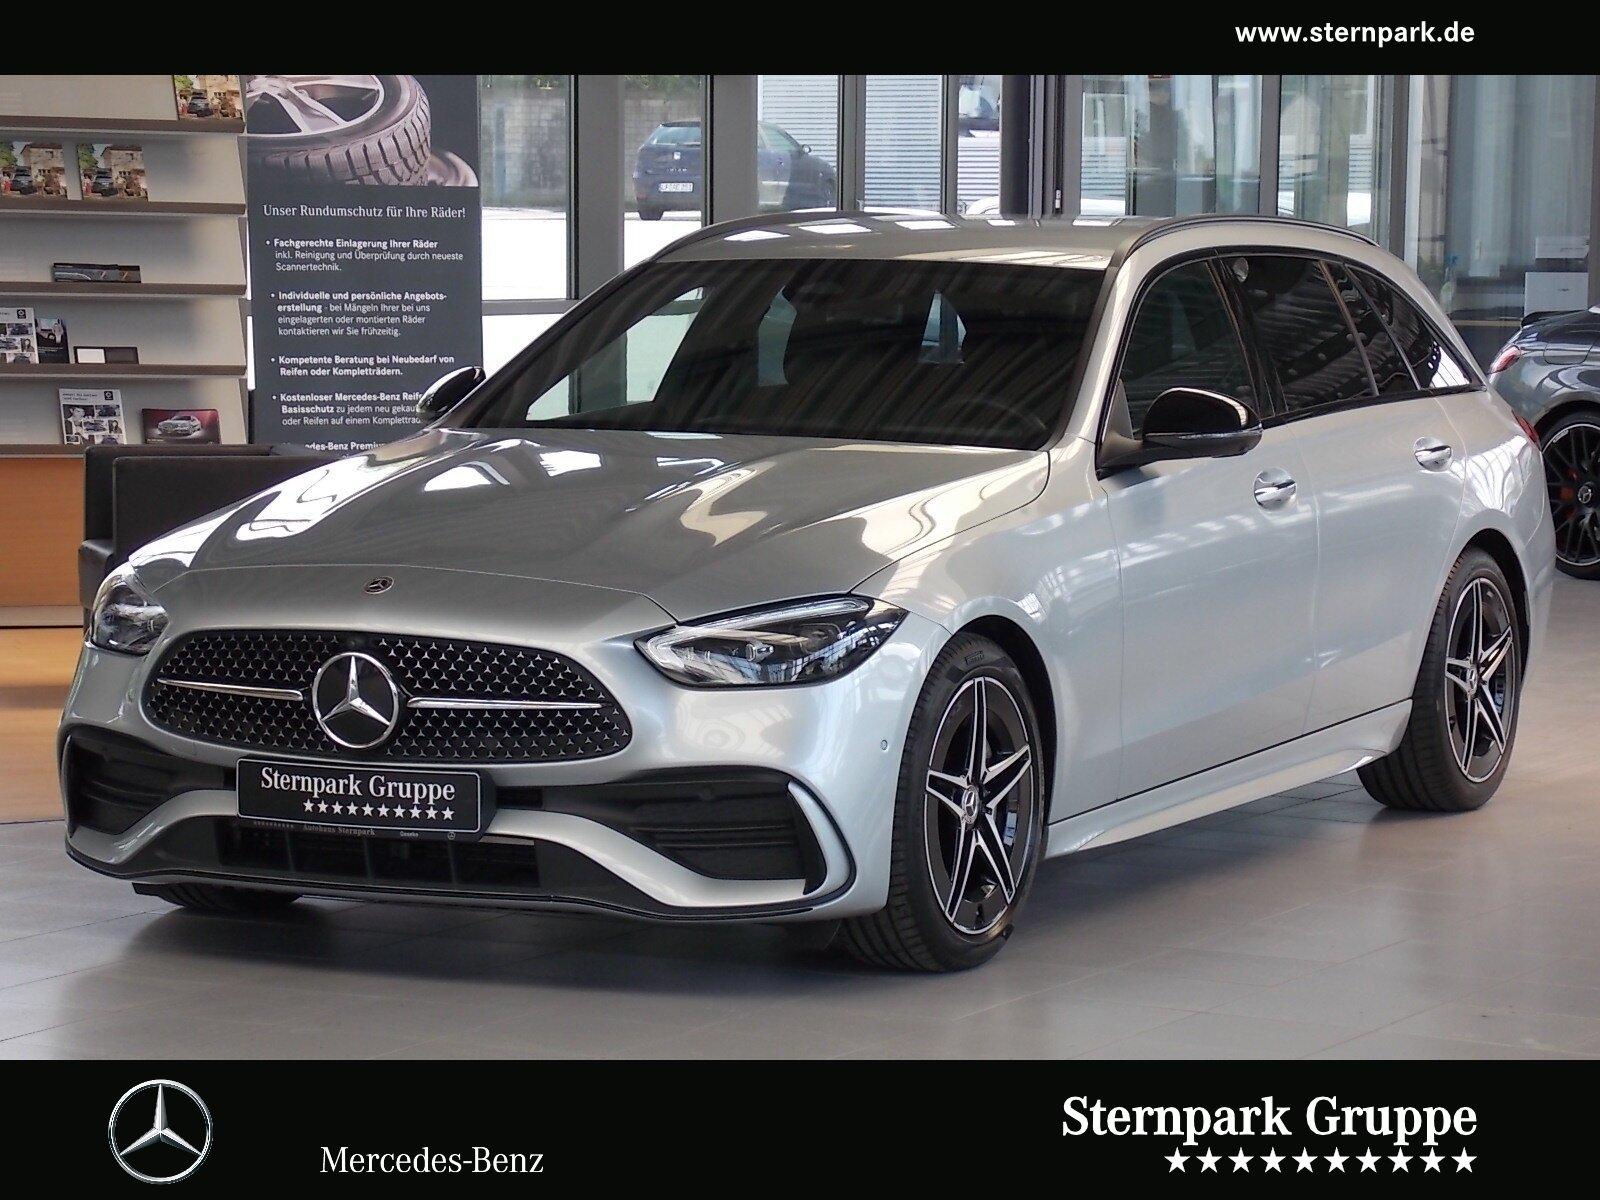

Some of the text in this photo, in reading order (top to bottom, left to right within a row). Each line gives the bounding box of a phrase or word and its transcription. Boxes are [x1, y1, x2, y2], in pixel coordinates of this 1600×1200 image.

[262, 204, 467, 218] Unser Rundumschutz für Ihre Räder!
[273, 238, 439, 250] Fachgerechte Einlagerung Ihrer Räder
[275, 249, 464, 262] inkl. Reinigung und Überprüfung durch neueste
[275, 262, 342, 272] Scannertechnik.
[278, 291, 447, 303] Individuelle und persönliche Angebots-
[277, 303, 323, 314] erstellung
[329, 303, 343, 313] bei
[344, 303, 379, 314] Mängeln
[380, 304, 400, 313] Ihrer
[401, 303, 414, 313] bei
[415, 304, 431, 313] uns
[277, 315, 426, 325] eingelagerten oder montierten Räder
[278, 326, 402, 338] kontaktieren wir Sie frühzeitig.
[278, 355, 455, 366] Kompetente Beratung bei Neubedarf von
[279, 367, 403, 378] Reifen oder Kompletträdern.
[280, 392, 333, 402] Kostenloser
[334, 392, 401, 402] Mercedes-Benz
[281, 404, 417, 415] Basisschutz zu jedem neu gekau
[282, 416, 301, 426] oder
[303, 416, 329, 426] Reifen
[330, 416, 344, 426] auf
[345, 416, 371, 426] einem
[260, 766, 456, 804] Sternpark Gruppe
[337, 826, 376, 837] Sternpark
